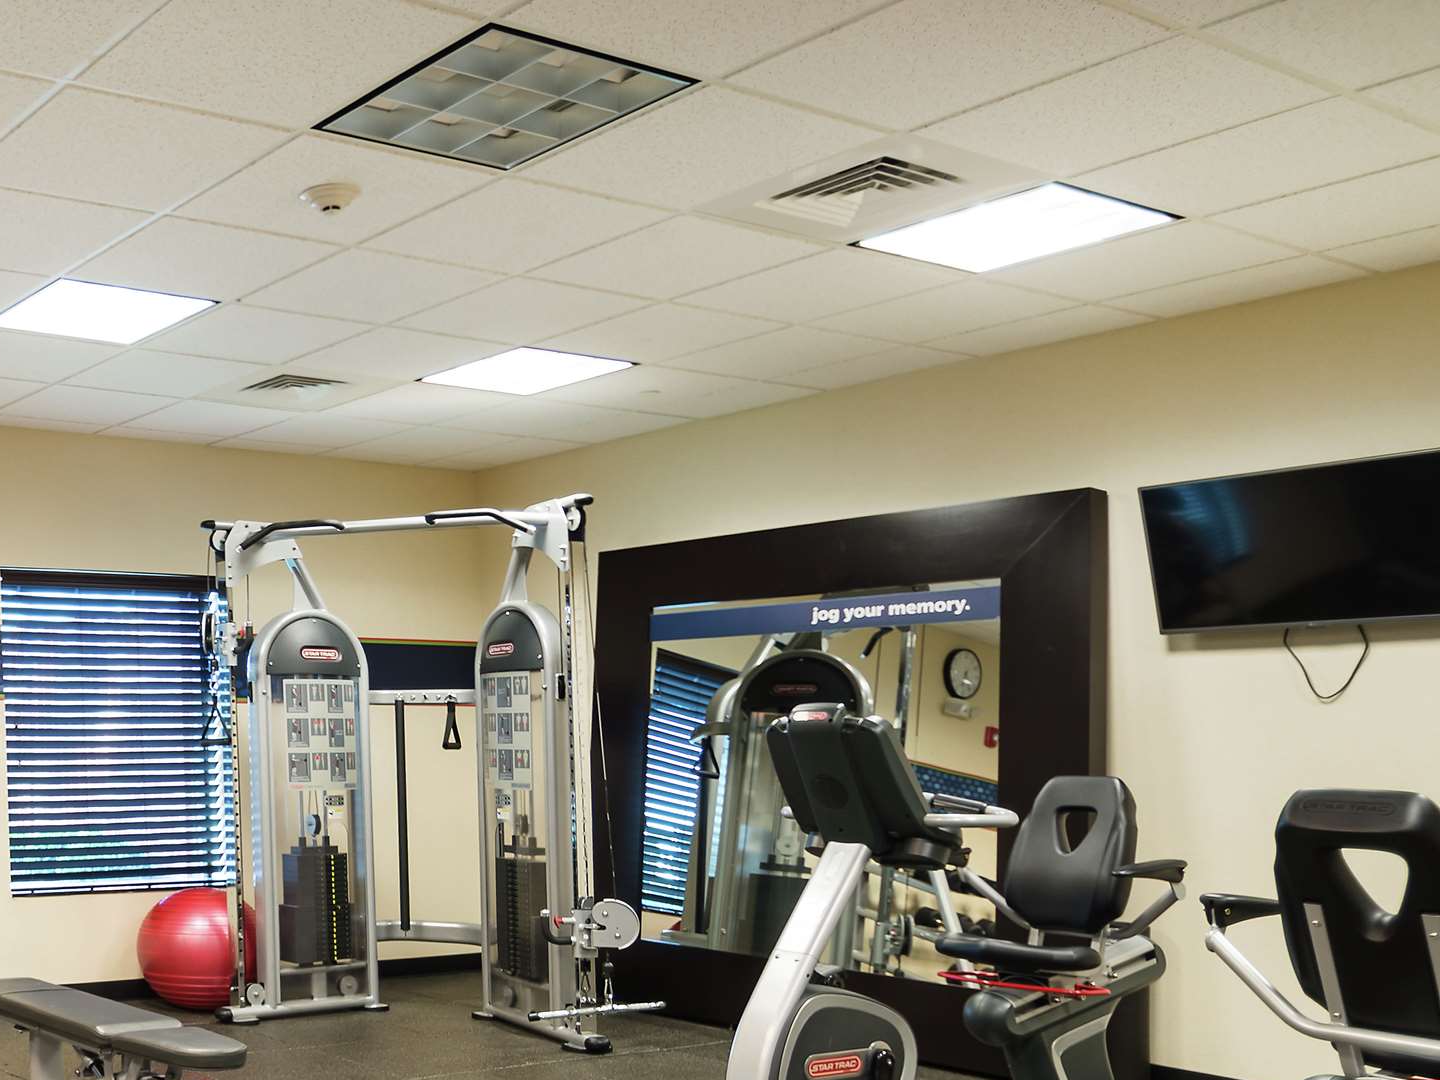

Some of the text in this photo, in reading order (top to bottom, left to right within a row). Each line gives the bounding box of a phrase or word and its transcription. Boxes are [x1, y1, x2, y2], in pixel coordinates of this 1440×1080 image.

[811, 598, 971, 624] jog your memory.
[811, 1060, 857, 1072] STAR TRAC
